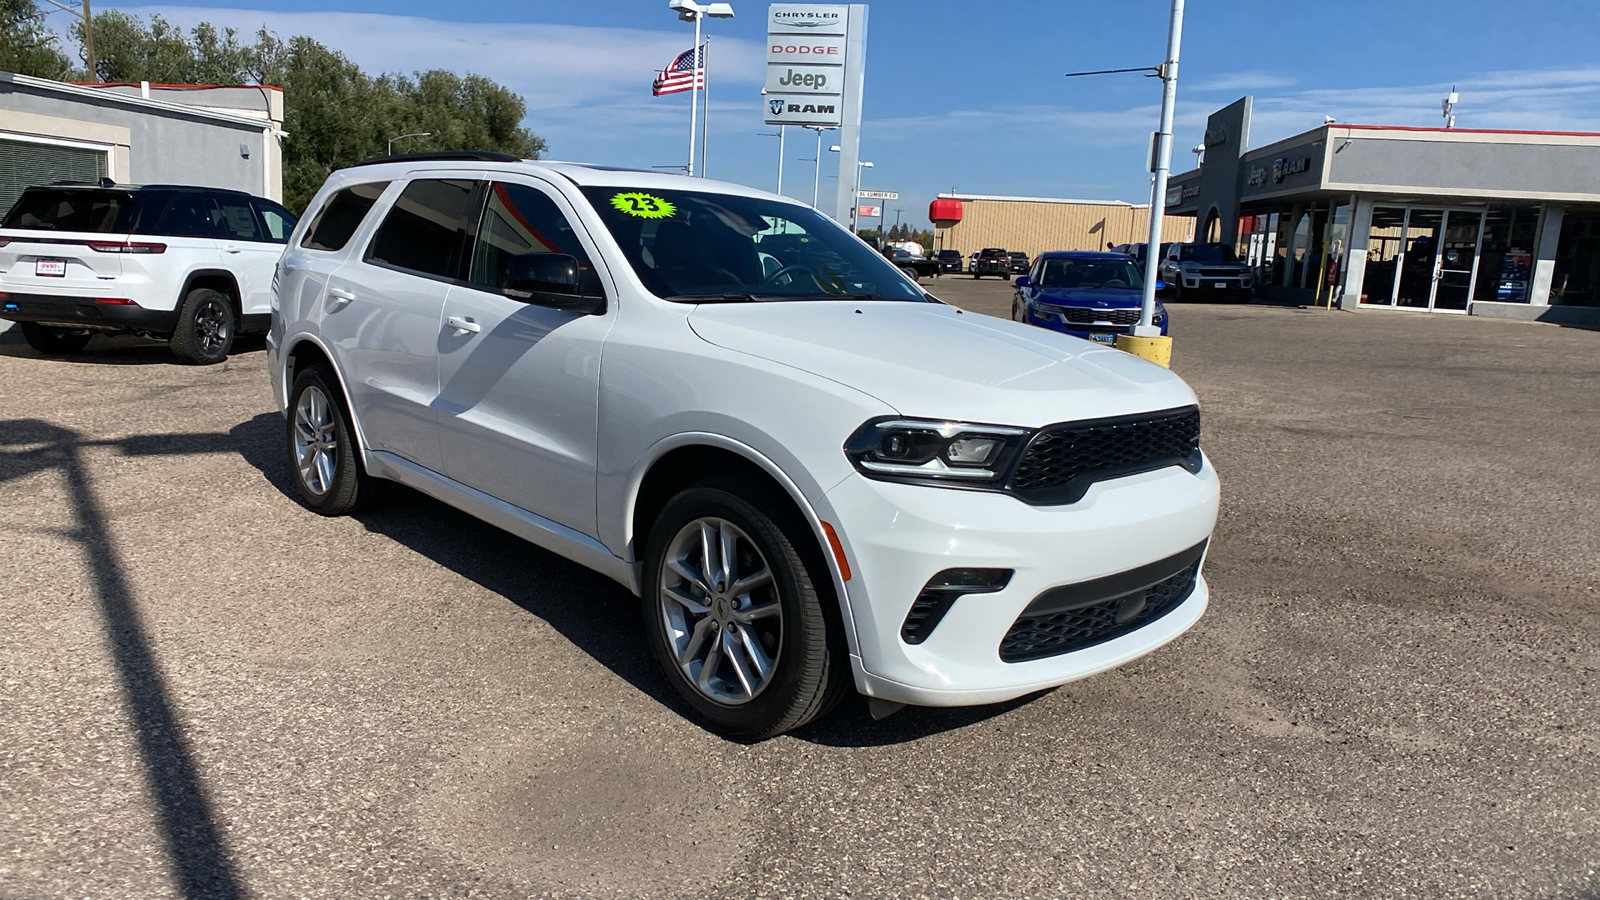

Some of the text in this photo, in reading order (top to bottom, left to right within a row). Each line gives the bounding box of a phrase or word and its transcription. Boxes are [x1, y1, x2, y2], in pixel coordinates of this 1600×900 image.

[771, 45, 838, 54] DODGE
[779, 69, 827, 90] Jeep
[787, 104, 835, 114] RAM
[624, 197, 660, 212] 23
